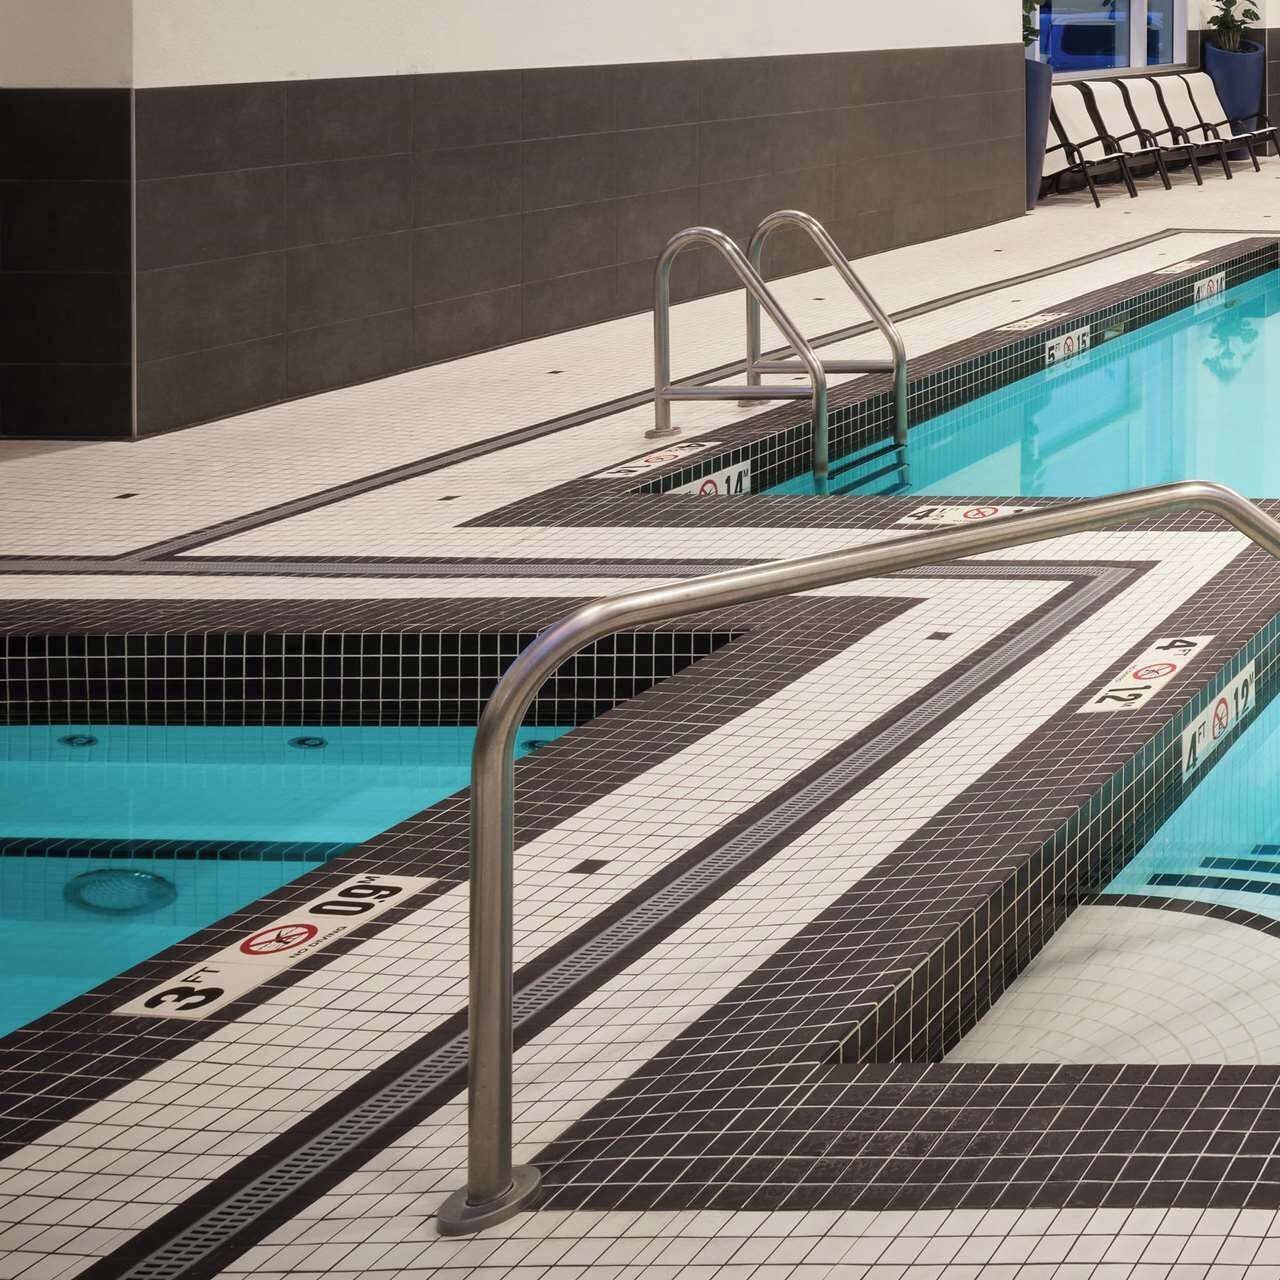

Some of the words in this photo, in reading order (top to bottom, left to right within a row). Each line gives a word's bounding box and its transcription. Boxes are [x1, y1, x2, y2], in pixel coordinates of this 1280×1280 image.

[356, 874, 381, 884] M
[180, 965, 220, 984] FT
[144, 986, 225, 1011] 3
